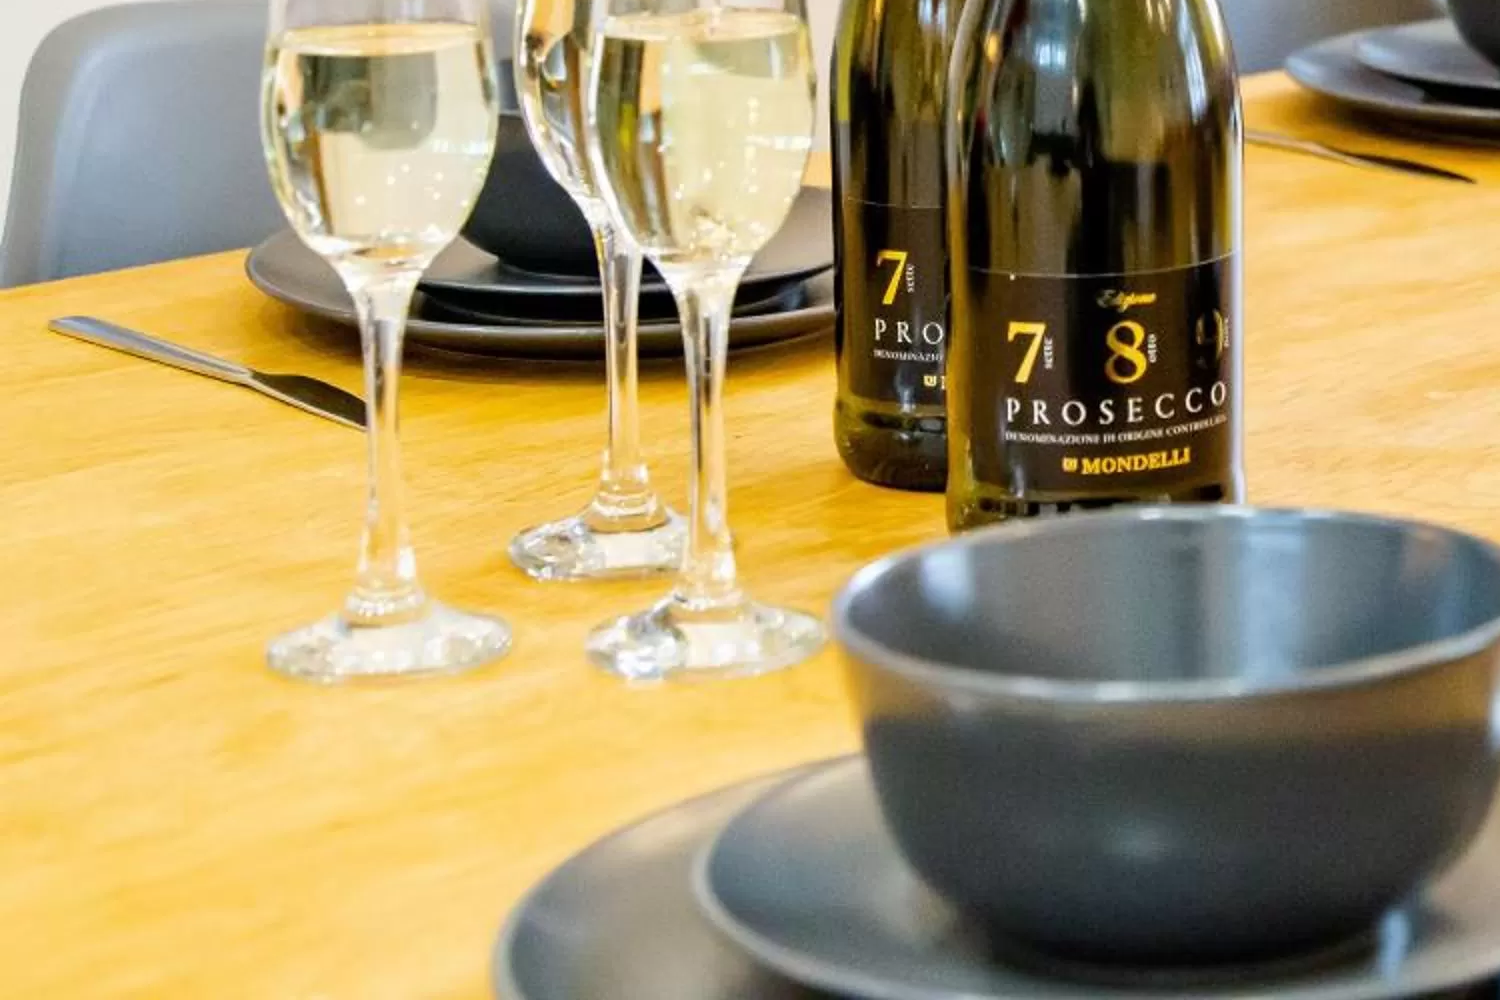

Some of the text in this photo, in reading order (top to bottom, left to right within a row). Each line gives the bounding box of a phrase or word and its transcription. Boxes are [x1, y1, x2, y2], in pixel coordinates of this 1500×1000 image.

[876, 250, 908, 305] 7
[874, 318, 944, 345] PRO
[1007, 321, 1047, 384] 7
[1104, 320, 1147, 384] 8
[1005, 381, 1227, 427] PROSECCO
[1080, 447, 1191, 476] MONDELLI
